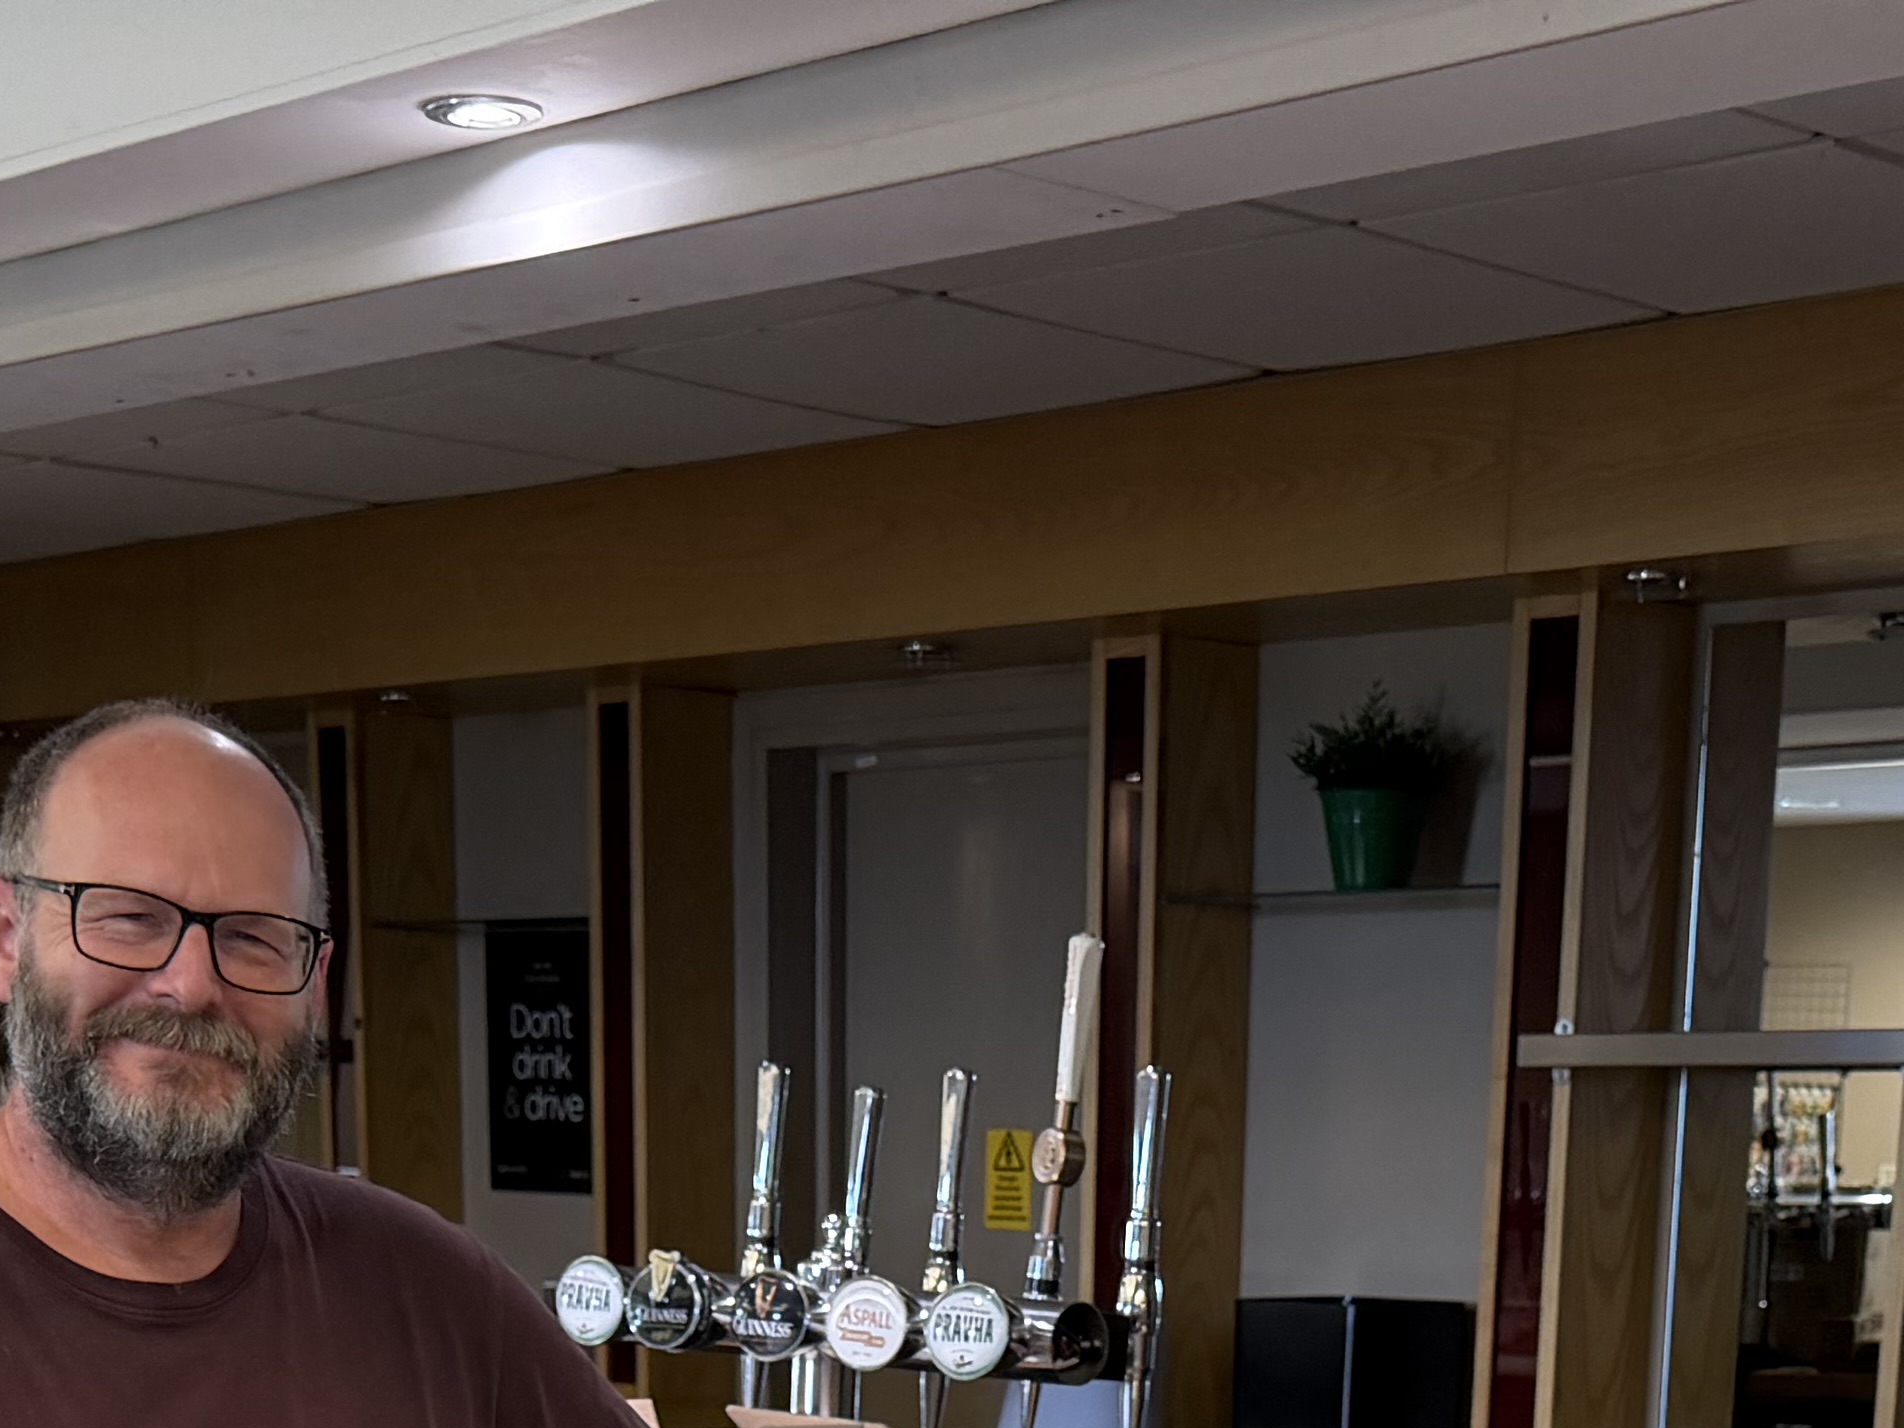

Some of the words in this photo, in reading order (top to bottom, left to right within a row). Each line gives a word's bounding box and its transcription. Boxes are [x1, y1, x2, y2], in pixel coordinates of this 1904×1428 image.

[510, 1003, 573, 1038] Don't
[512, 1047, 572, 1081] drink
[524, 1086, 584, 1123] drive
[839, 1304, 892, 1330] ASPALL
[933, 1315, 994, 1345] PRAVHA
